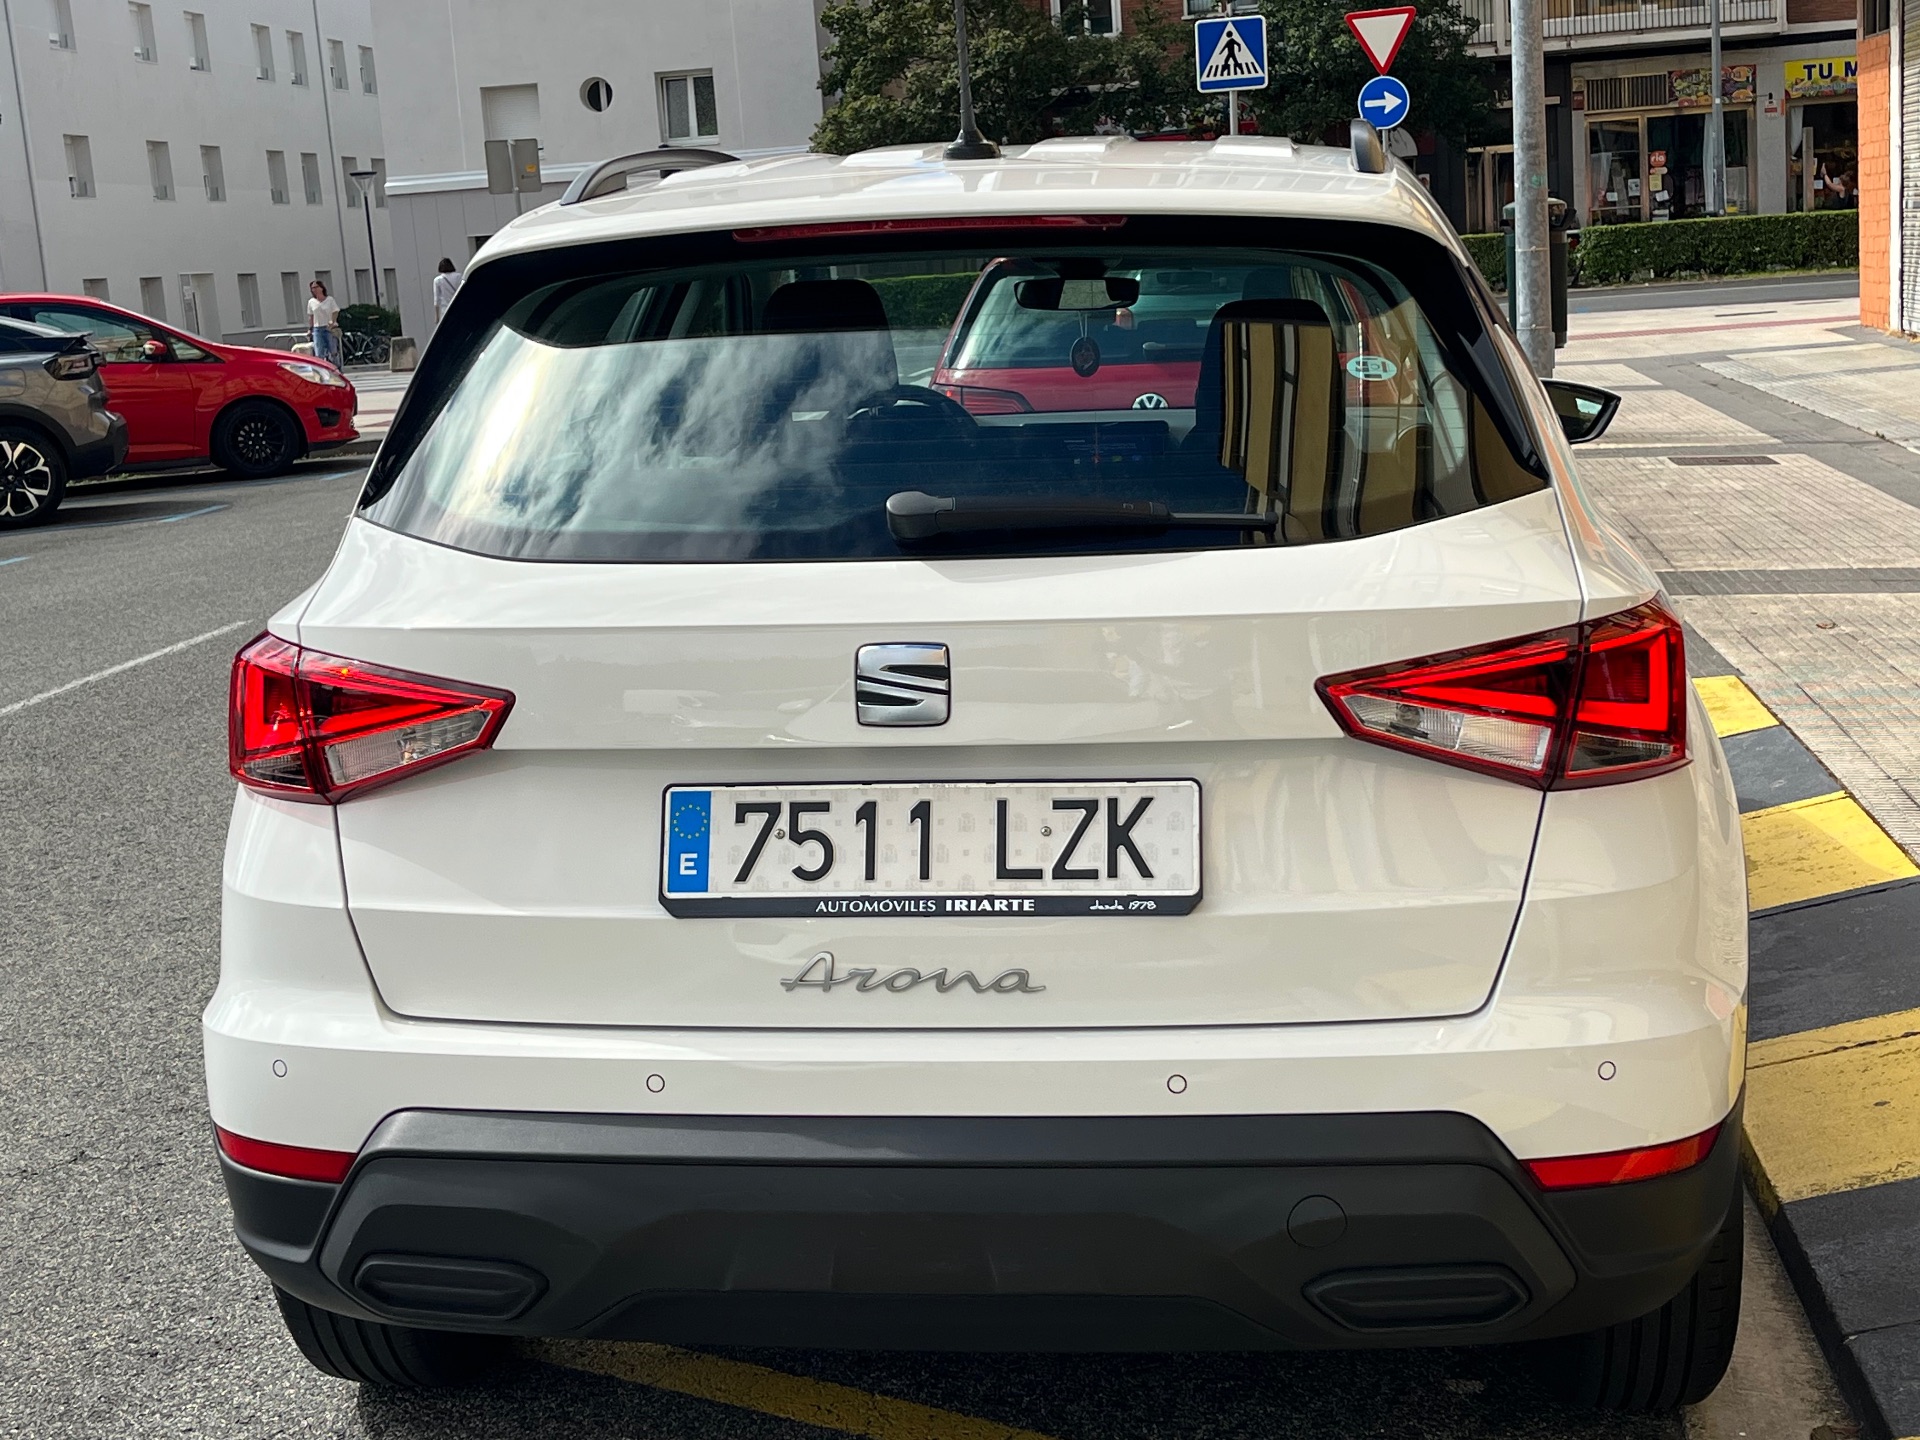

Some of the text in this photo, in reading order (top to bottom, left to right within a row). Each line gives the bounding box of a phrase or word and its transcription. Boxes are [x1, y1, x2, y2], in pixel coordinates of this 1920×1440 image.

[1803, 63, 1833, 81] TU
[734, 797, 1155, 882] 7511 LZK
[679, 853, 698, 875] E
[815, 898, 1157, 913] AUTOMÓVILES IRIARTE desde 1978
[780, 950, 1047, 993] Arona
